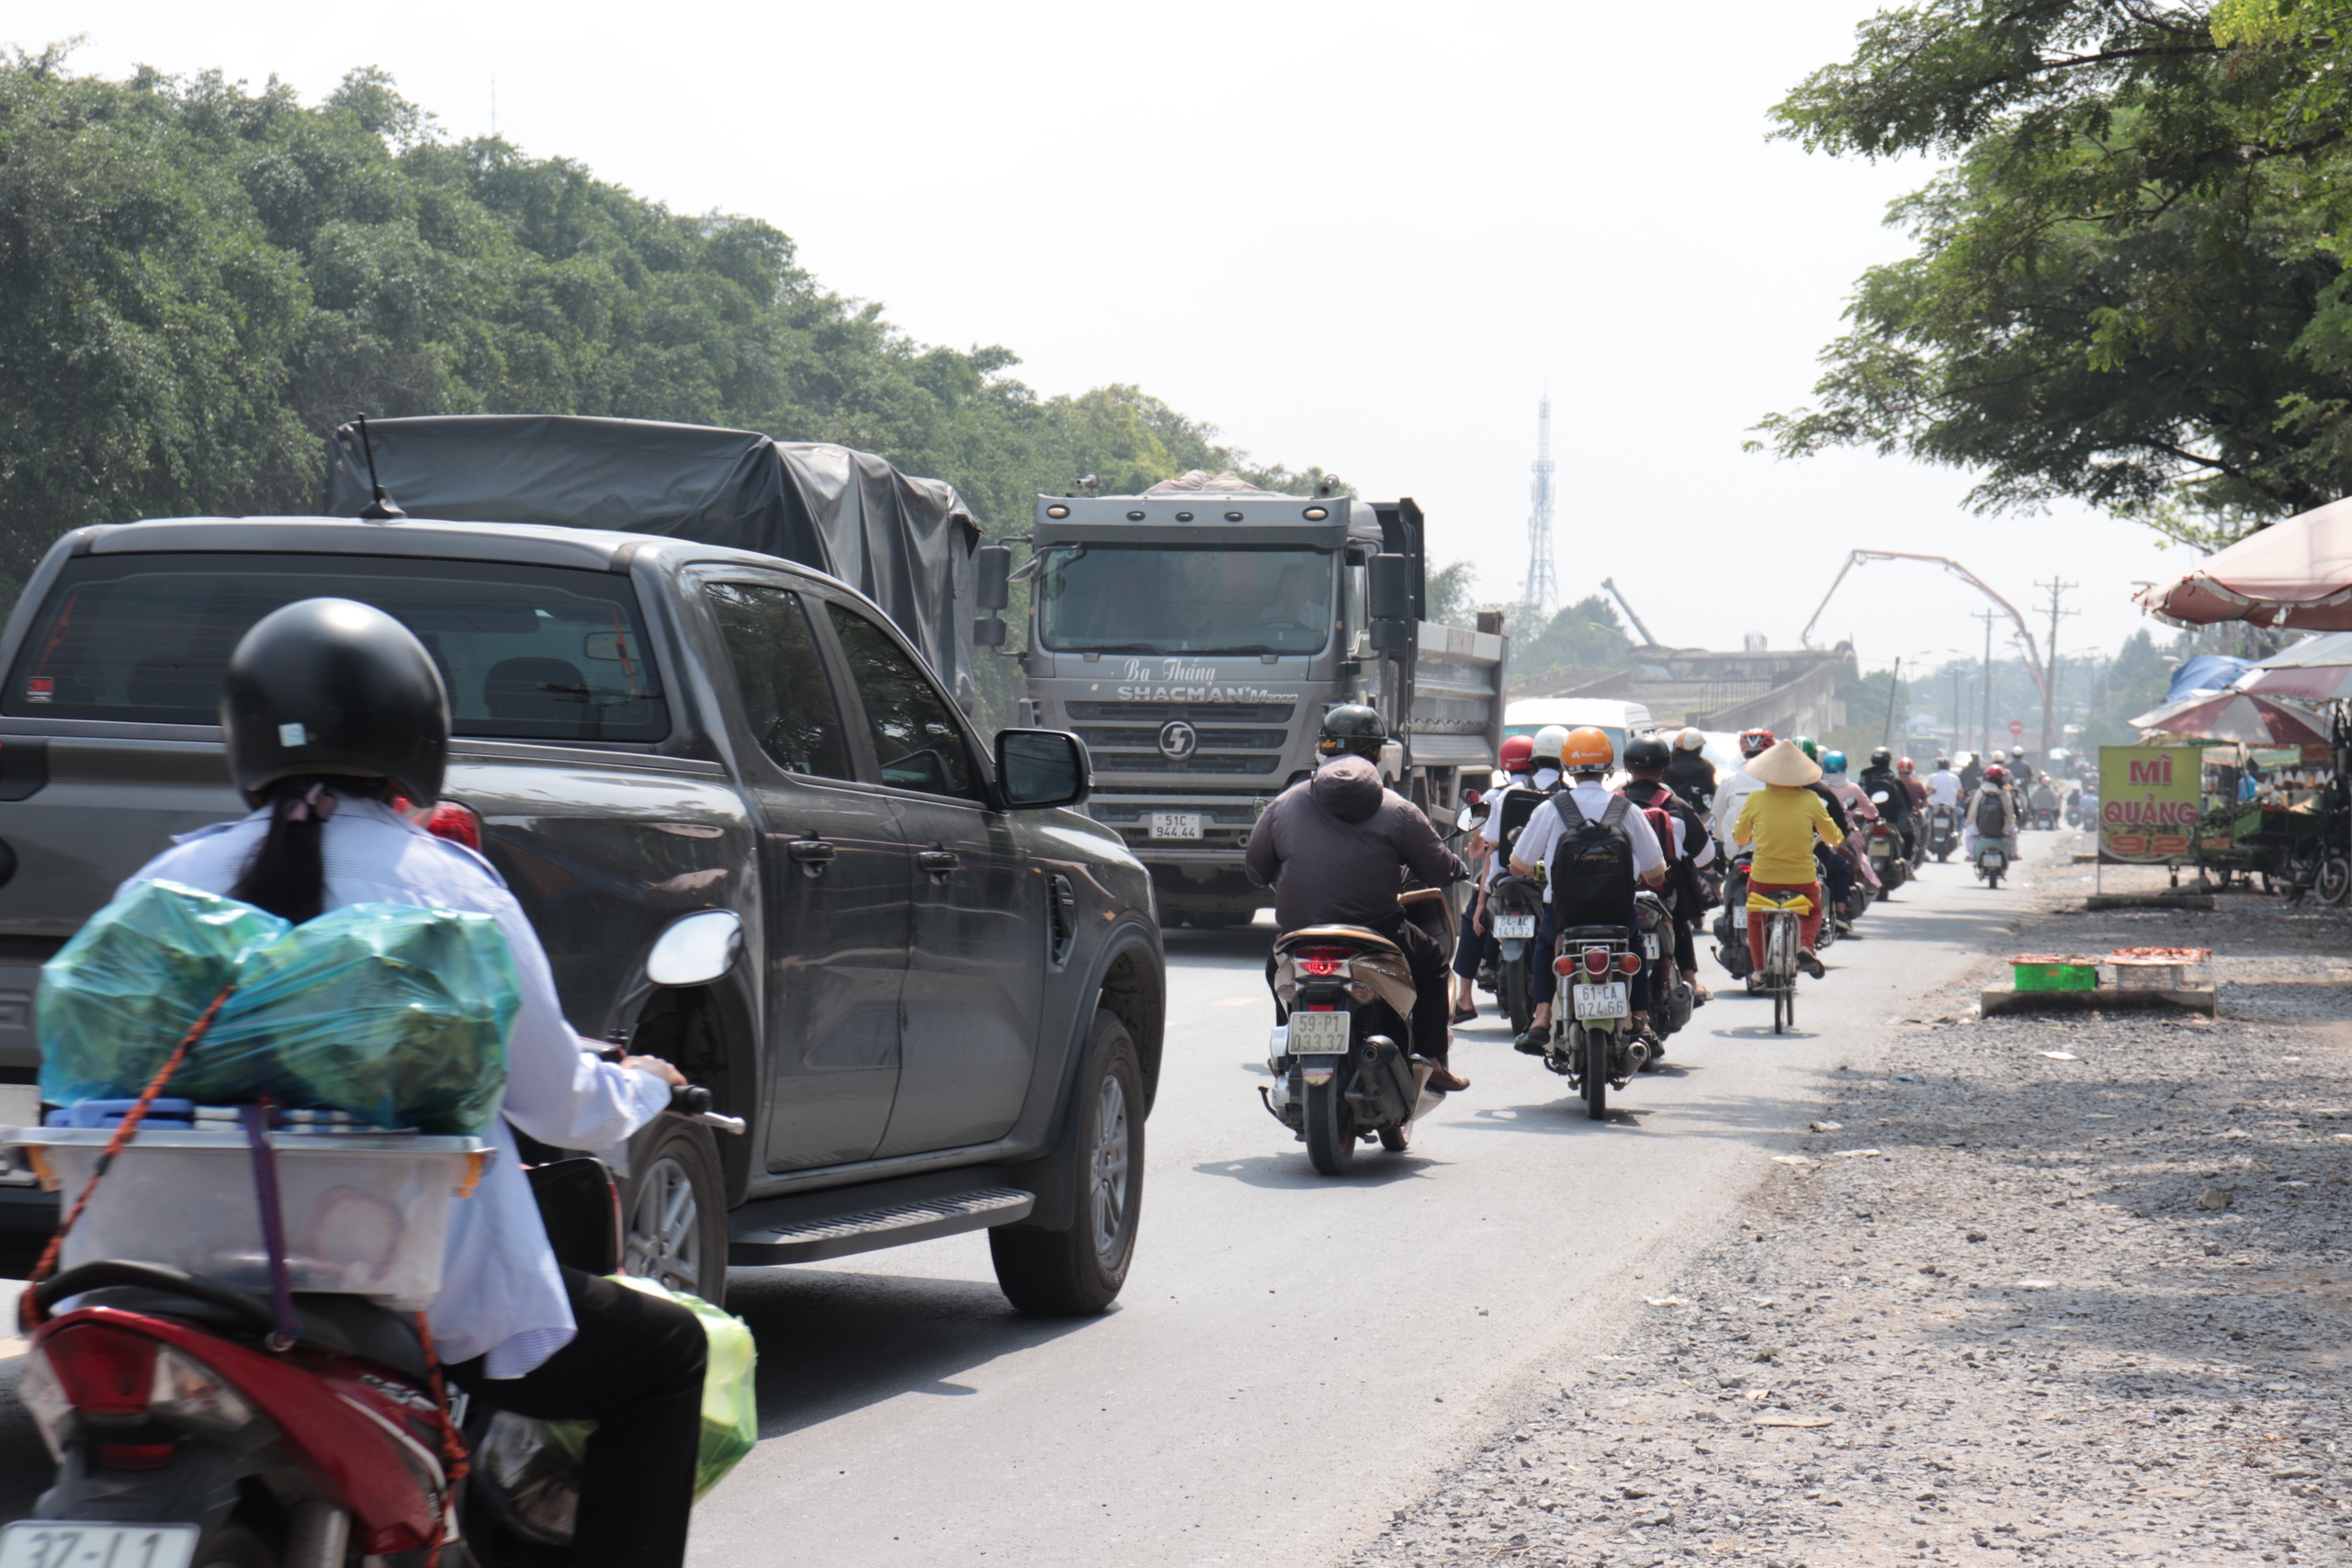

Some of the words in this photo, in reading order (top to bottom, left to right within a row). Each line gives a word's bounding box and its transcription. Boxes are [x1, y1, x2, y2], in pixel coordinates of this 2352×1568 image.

[1124, 658, 1150, 682] Ba
[1117, 686, 1243, 702] SHACMAN
[1250, 689, 1298, 703] M3000
[2128, 752, 2172, 784] MÌ
[2103, 792, 2197, 825] QUẢNG
[1165, 815, 1187, 826] 51C
[1156, 826, 1195, 837] 944.44
[2110, 834, 2188, 855] 92
[1500, 917, 1529, 927] 64-AC
[1582, 986, 1617, 1001] 61-CA
[1299, 1015, 1339, 1032] 59-P1
